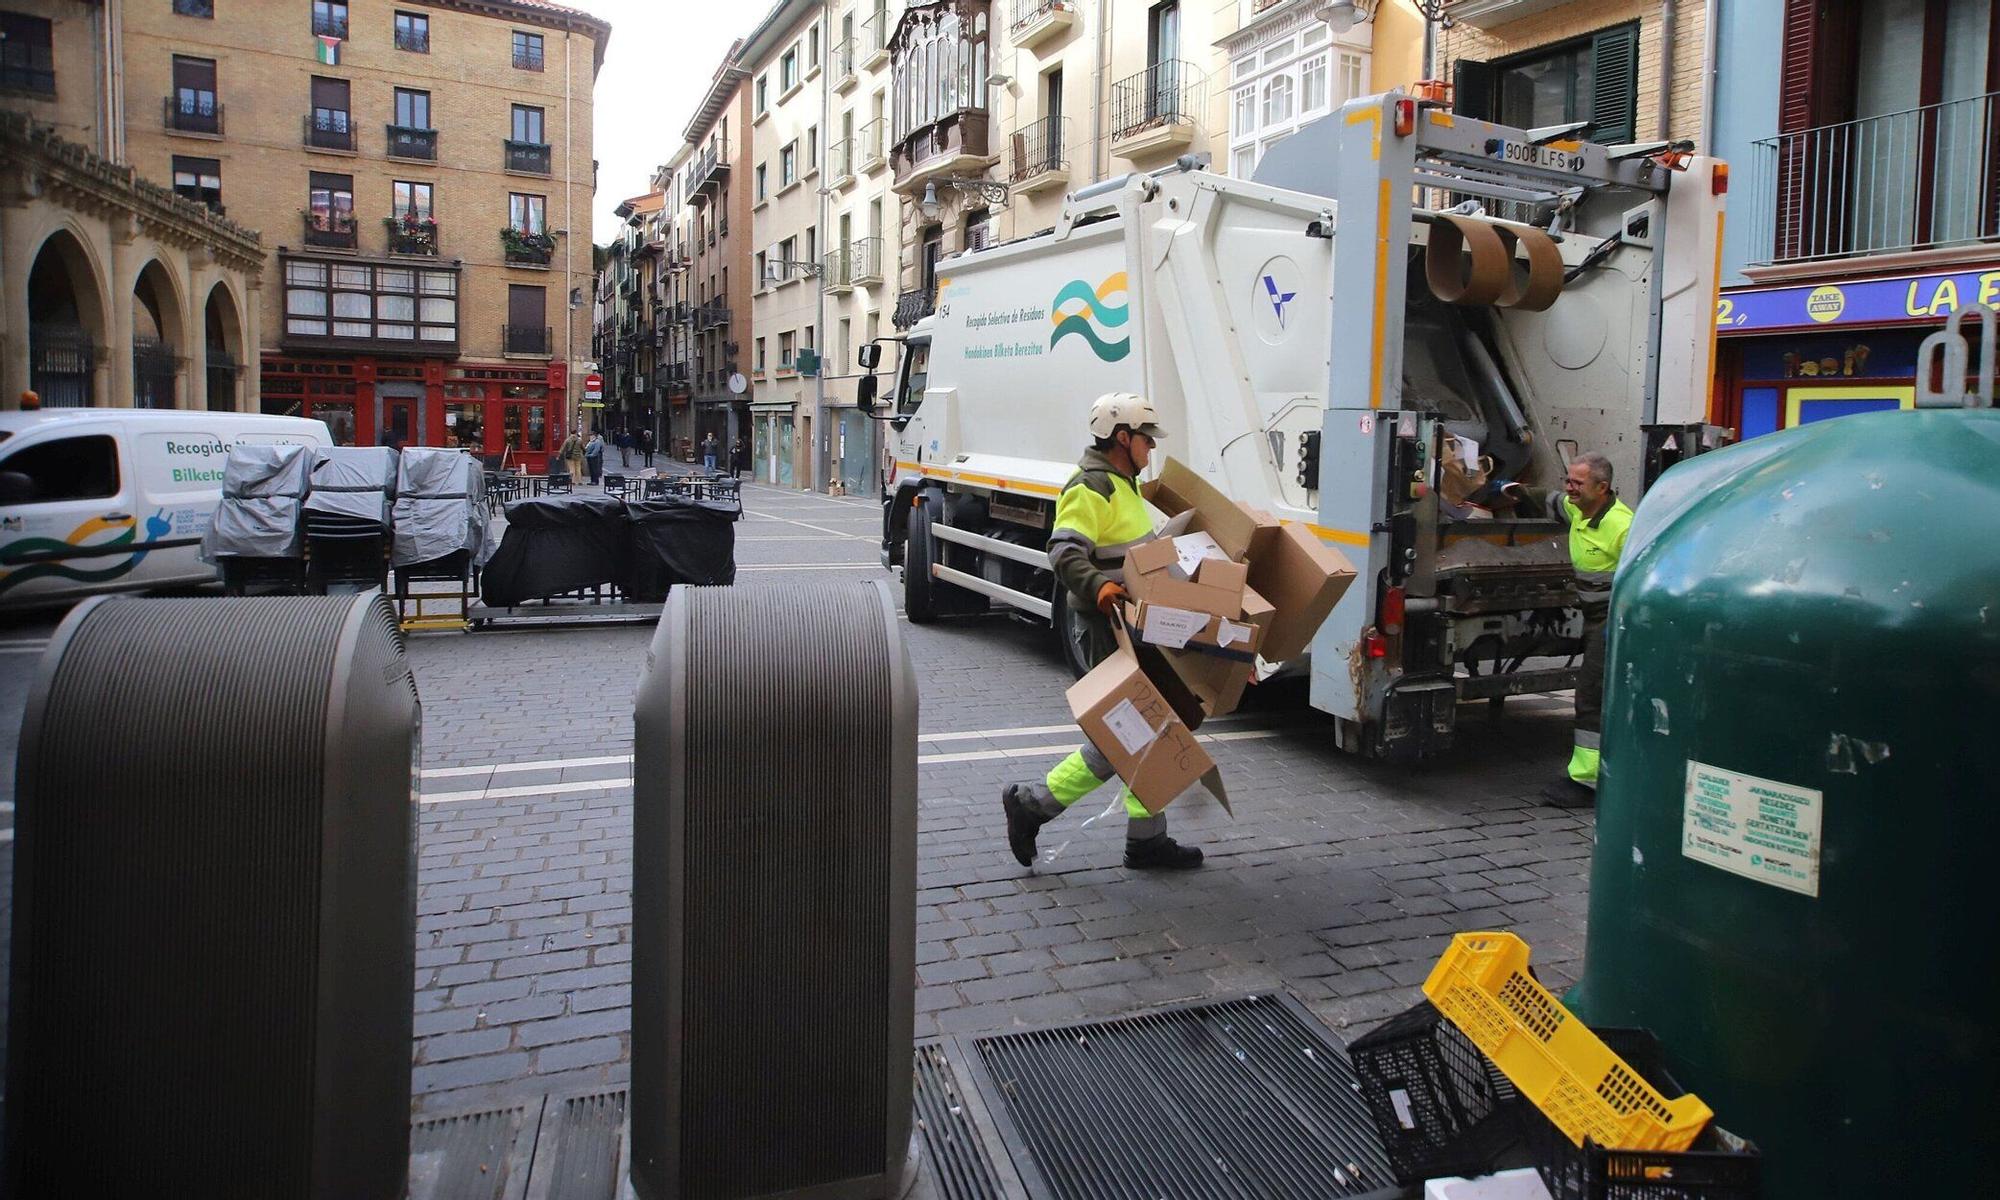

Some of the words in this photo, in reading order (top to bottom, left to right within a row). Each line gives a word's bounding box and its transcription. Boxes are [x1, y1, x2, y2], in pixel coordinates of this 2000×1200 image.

[1506, 143, 1537, 163] 9008
[1541, 150, 1565, 168] LFS
[1812, 293, 1840, 302] TAKE
[1906, 279, 1959, 316] LA
[939, 304, 951, 319] 154
[1811, 302, 1841, 312] AWAY
[966, 313, 987, 331] Recogida
[987, 311, 1010, 326] Selectiva
[1011, 309, 1018, 323] de
[1020, 306, 1045, 322] Residuos
[994, 343, 1014, 357] Bilketa
[1014, 342, 1043, 356] Berezitua
